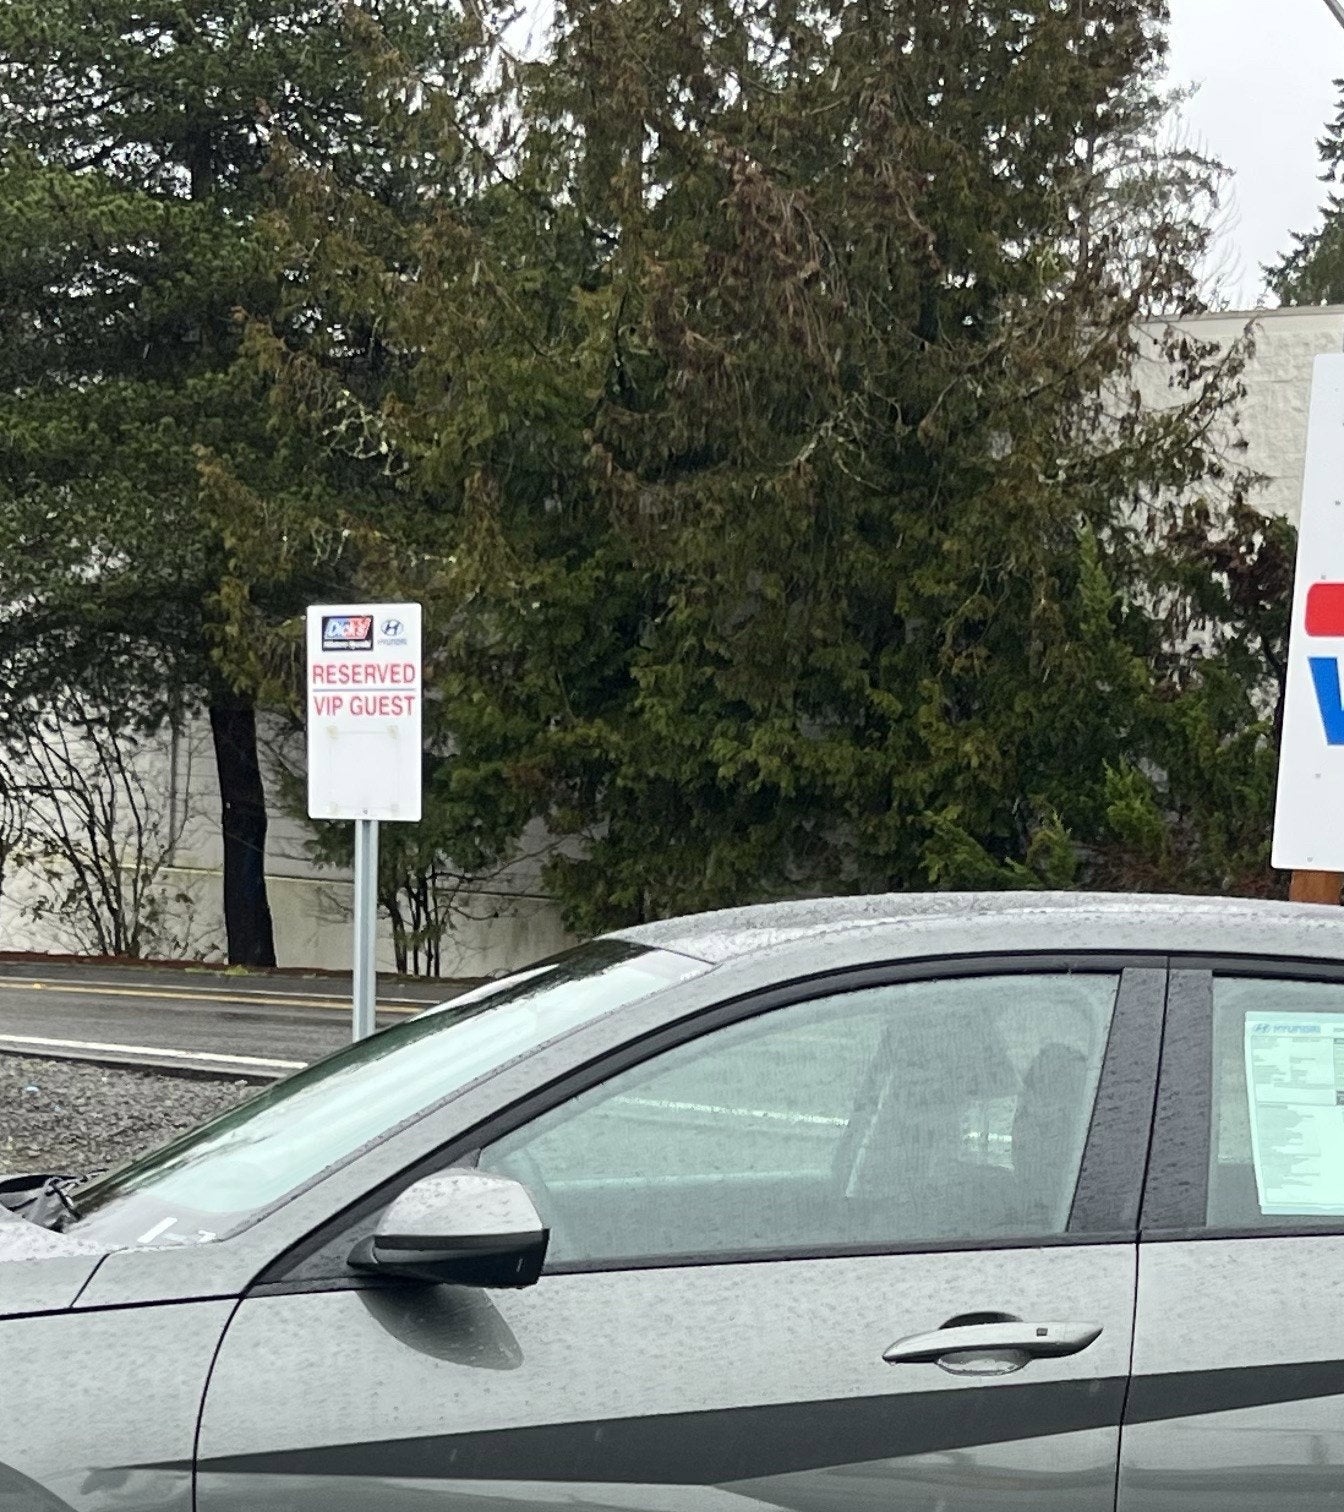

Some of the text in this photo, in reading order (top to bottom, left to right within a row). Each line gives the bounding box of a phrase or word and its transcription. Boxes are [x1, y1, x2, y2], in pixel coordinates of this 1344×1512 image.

[312, 663, 416, 684] RESERVED
[313, 695, 416, 716] VIP GUEST
